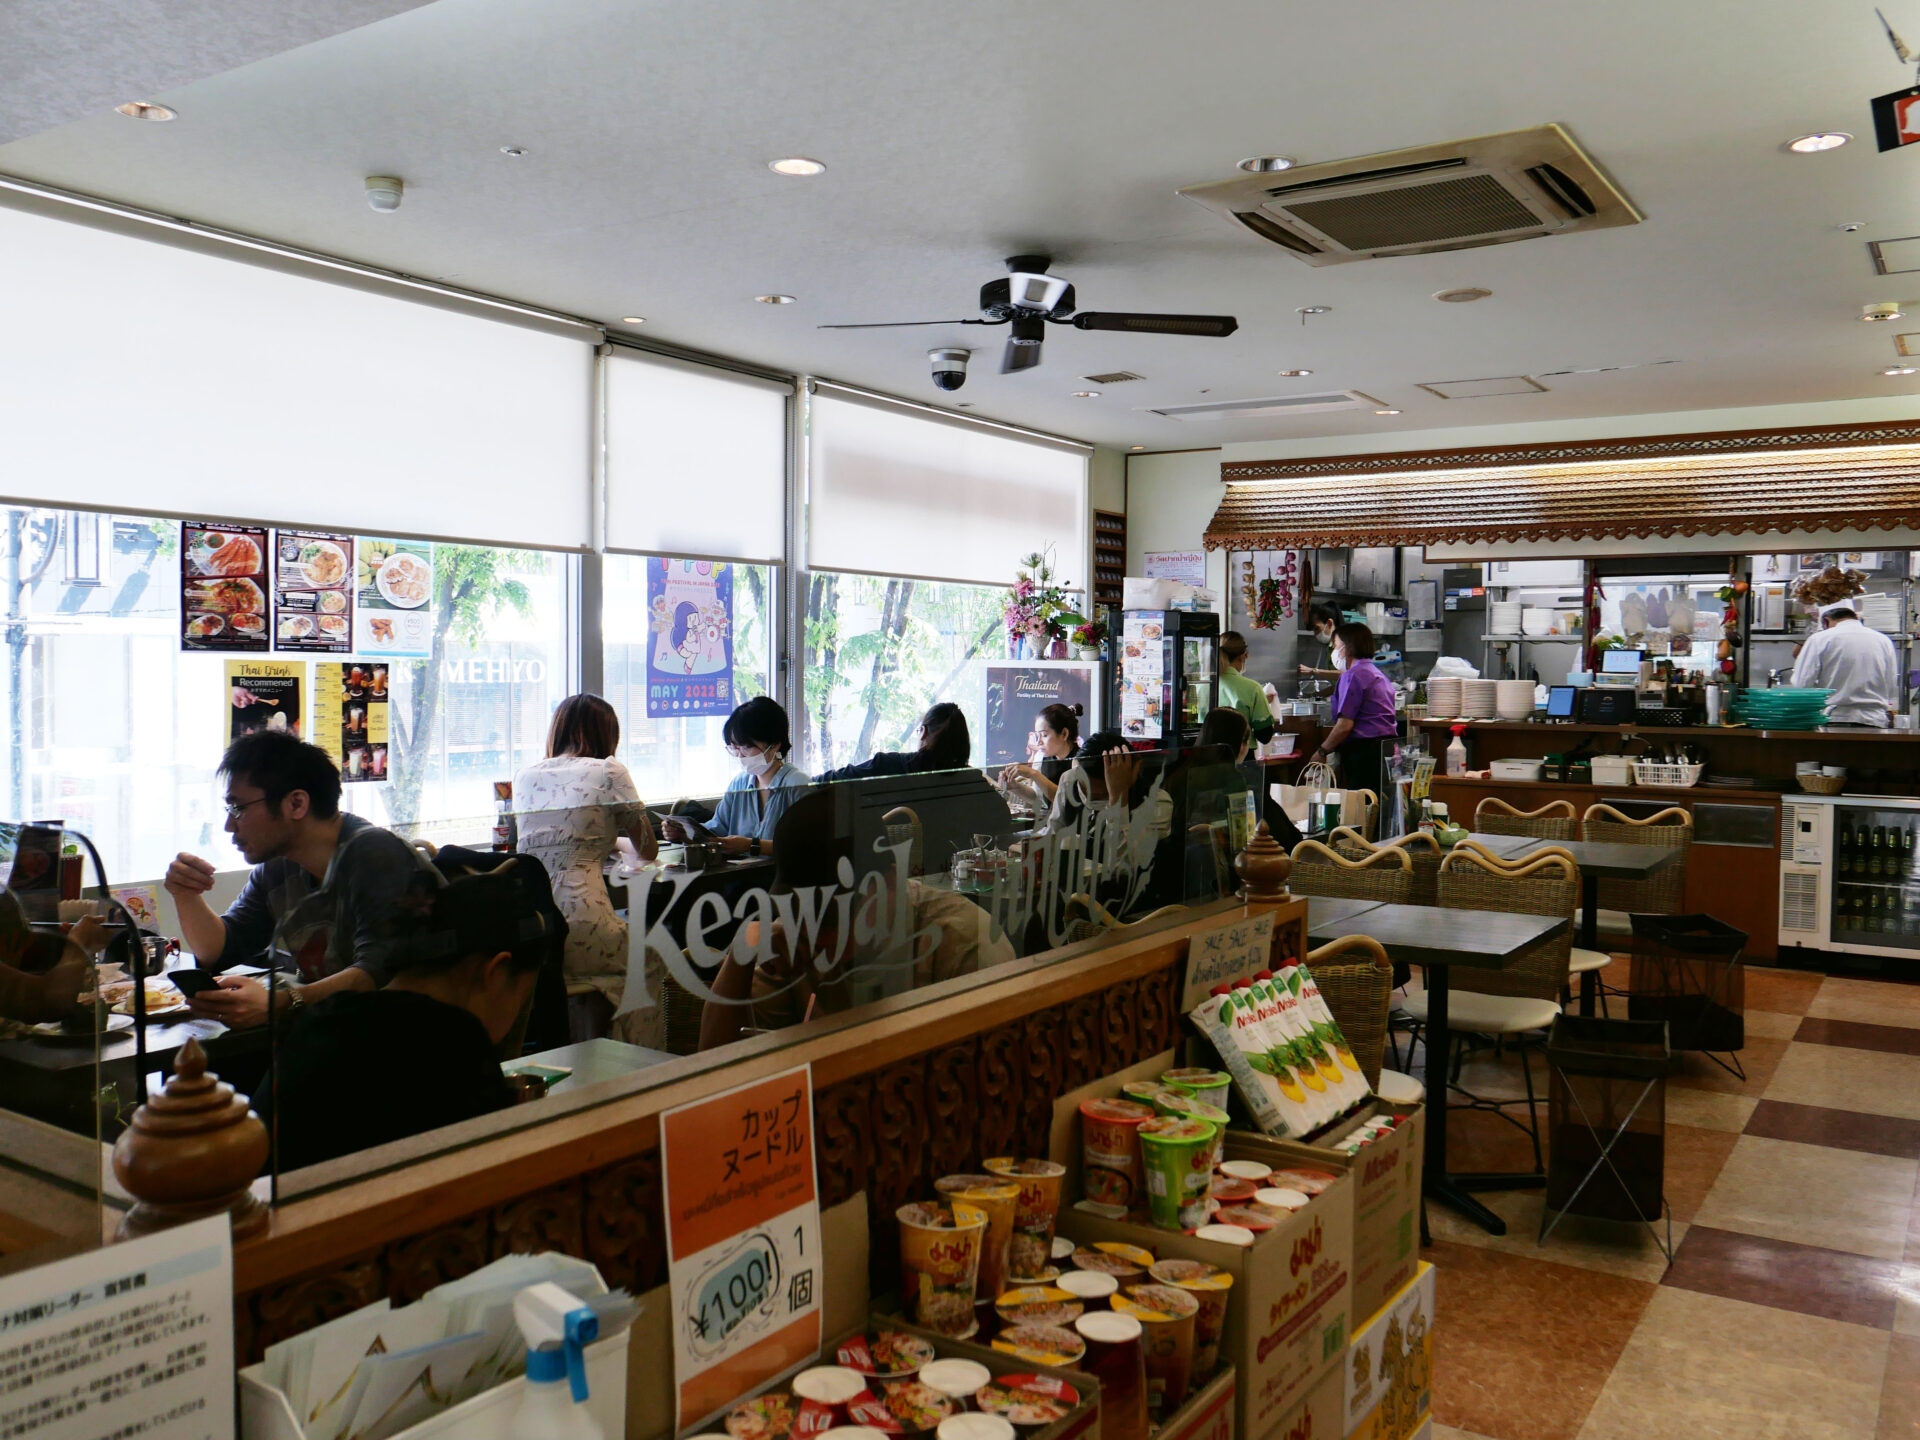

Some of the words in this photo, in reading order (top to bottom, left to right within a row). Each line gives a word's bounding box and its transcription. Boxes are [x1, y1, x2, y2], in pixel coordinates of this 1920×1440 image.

[239, 664, 262, 676] Thai
[264, 664, 291, 677] Drink
[396, 658, 546, 684] KMEHYO
[239, 678, 293, 687] Recommened
[651, 684, 679, 698] MAY
[685, 684, 715, 698] 2022
[1014, 675, 1061, 692] Thailand
[743, 1088, 803, 1142] カップ
[722, 1126, 805, 1182] ヌードル
[689, 1250, 773, 1339] ¥100!
